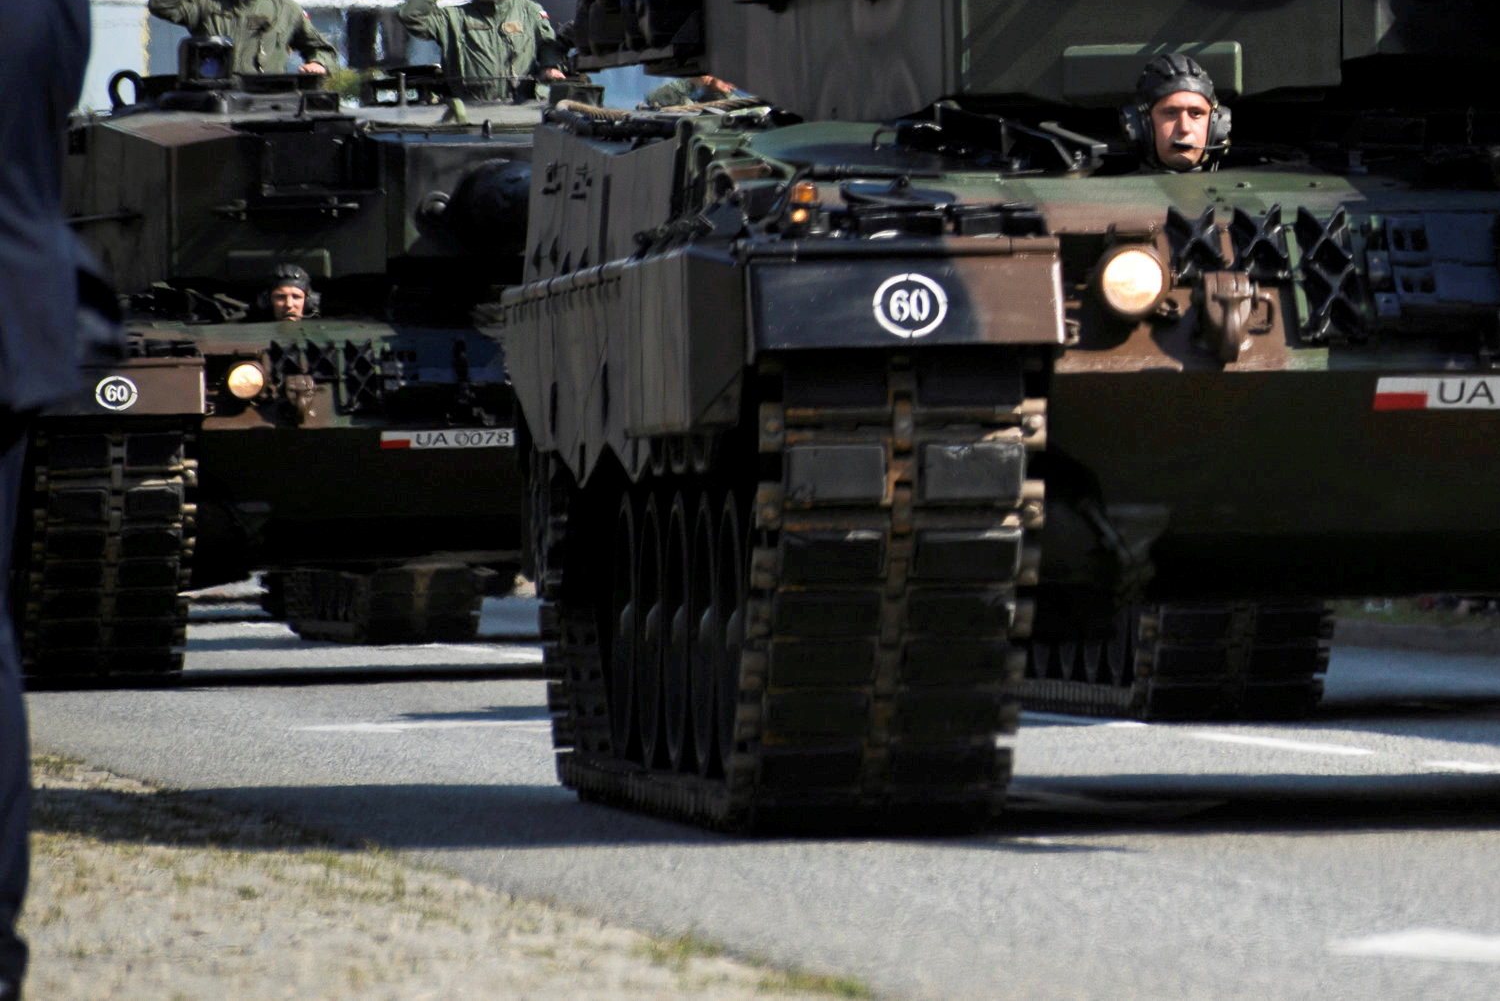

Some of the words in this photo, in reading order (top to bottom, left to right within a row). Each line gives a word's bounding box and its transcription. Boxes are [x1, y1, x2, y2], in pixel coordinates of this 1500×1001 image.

[889, 288, 931, 322] 60
[104, 384, 129, 402] 60
[1438, 379, 1496, 405] UA
[415, 432, 449, 447] UA
